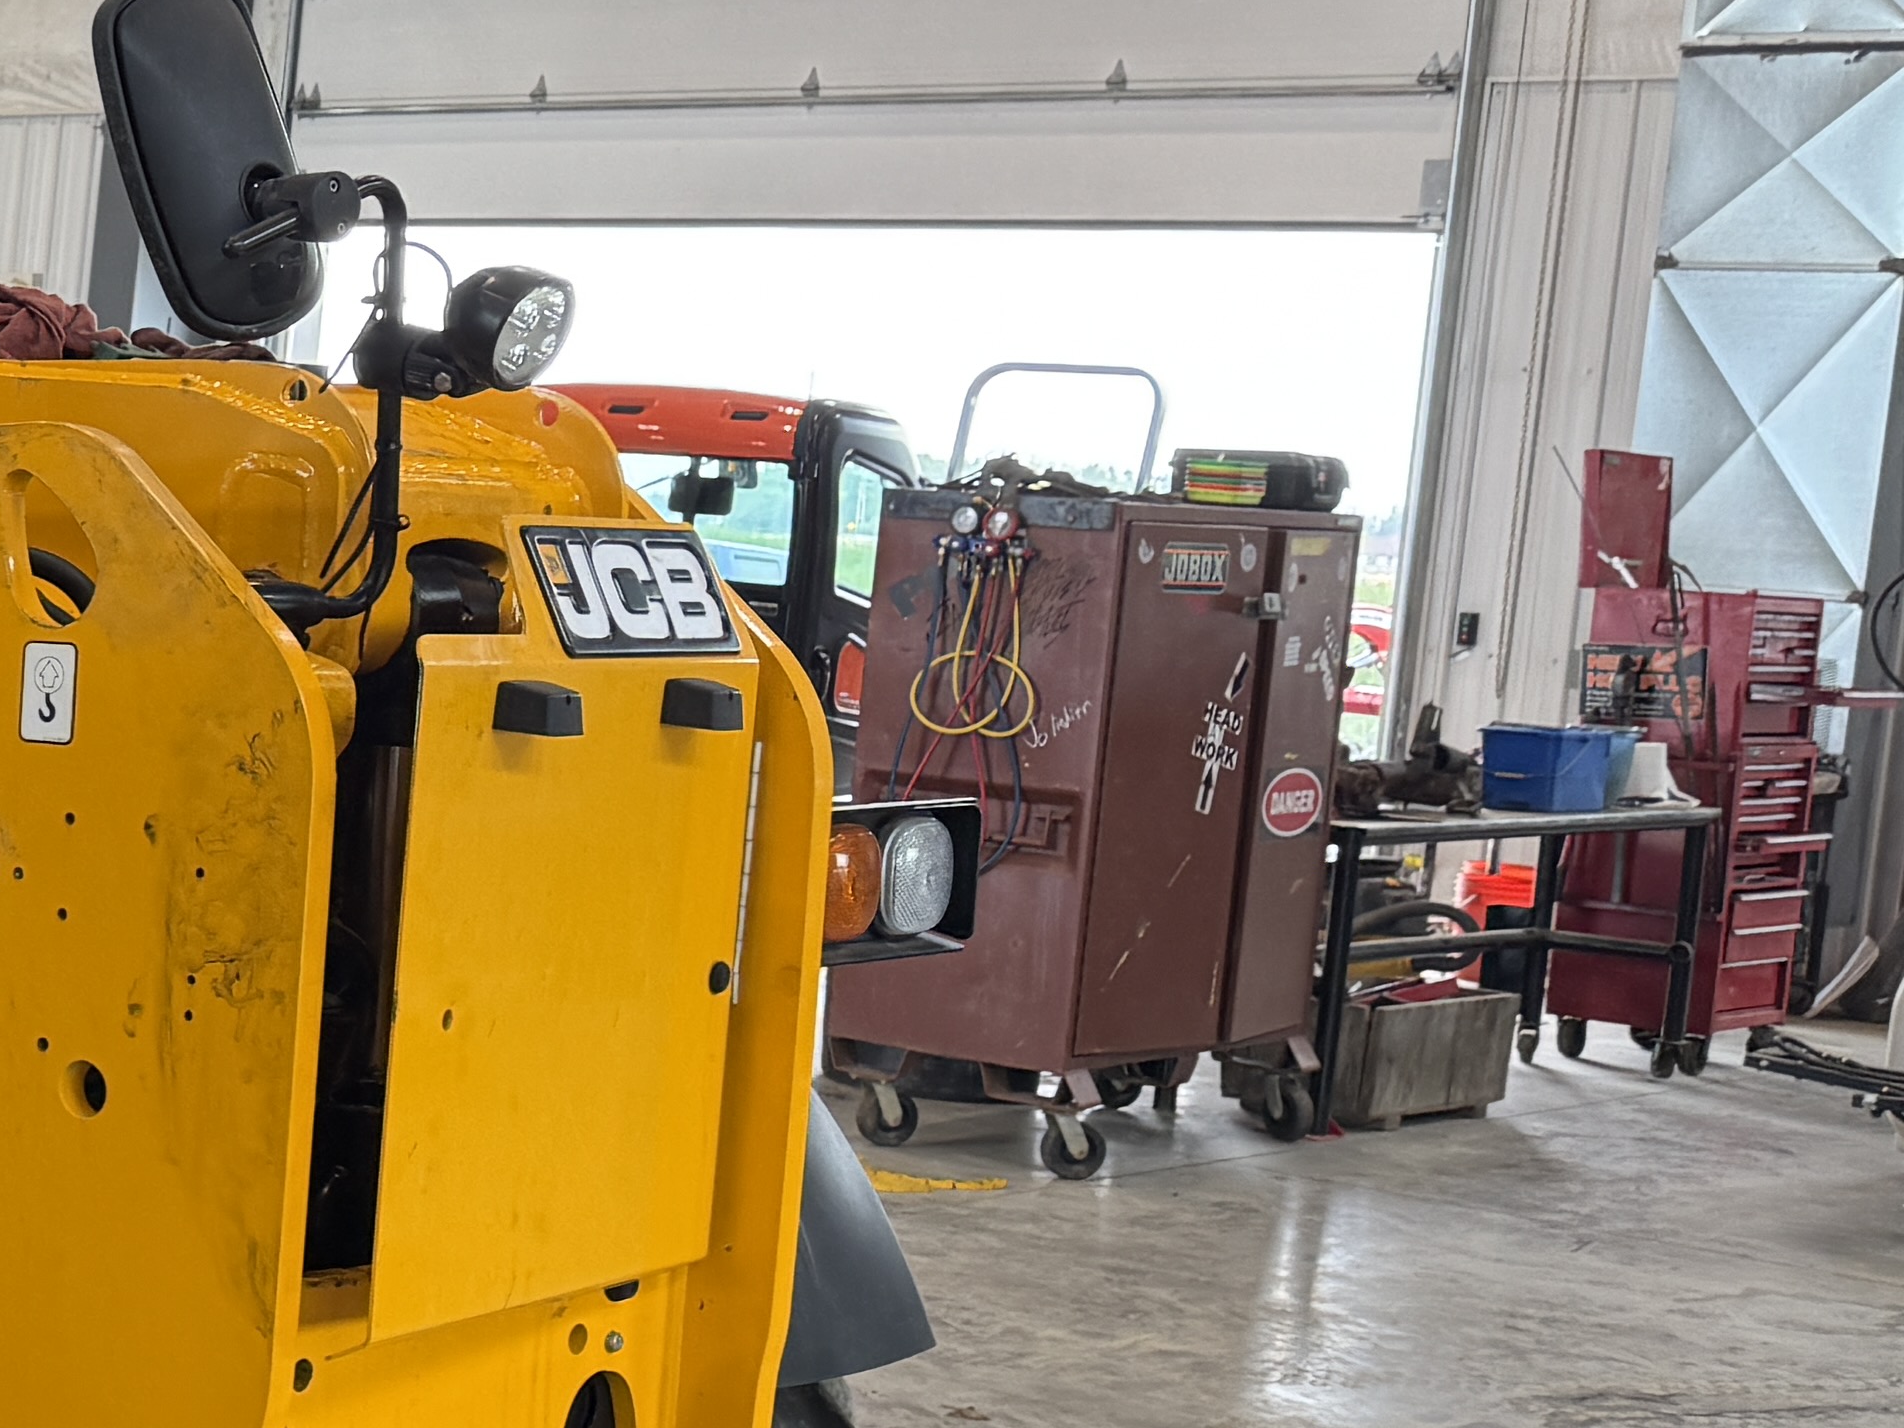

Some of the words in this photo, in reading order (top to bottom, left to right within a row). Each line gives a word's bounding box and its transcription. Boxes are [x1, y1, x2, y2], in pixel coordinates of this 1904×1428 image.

[1164, 553, 1226, 582] JOBOX
[537, 539, 725, 640] JCB
[1193, 735, 1238, 770] WORK
